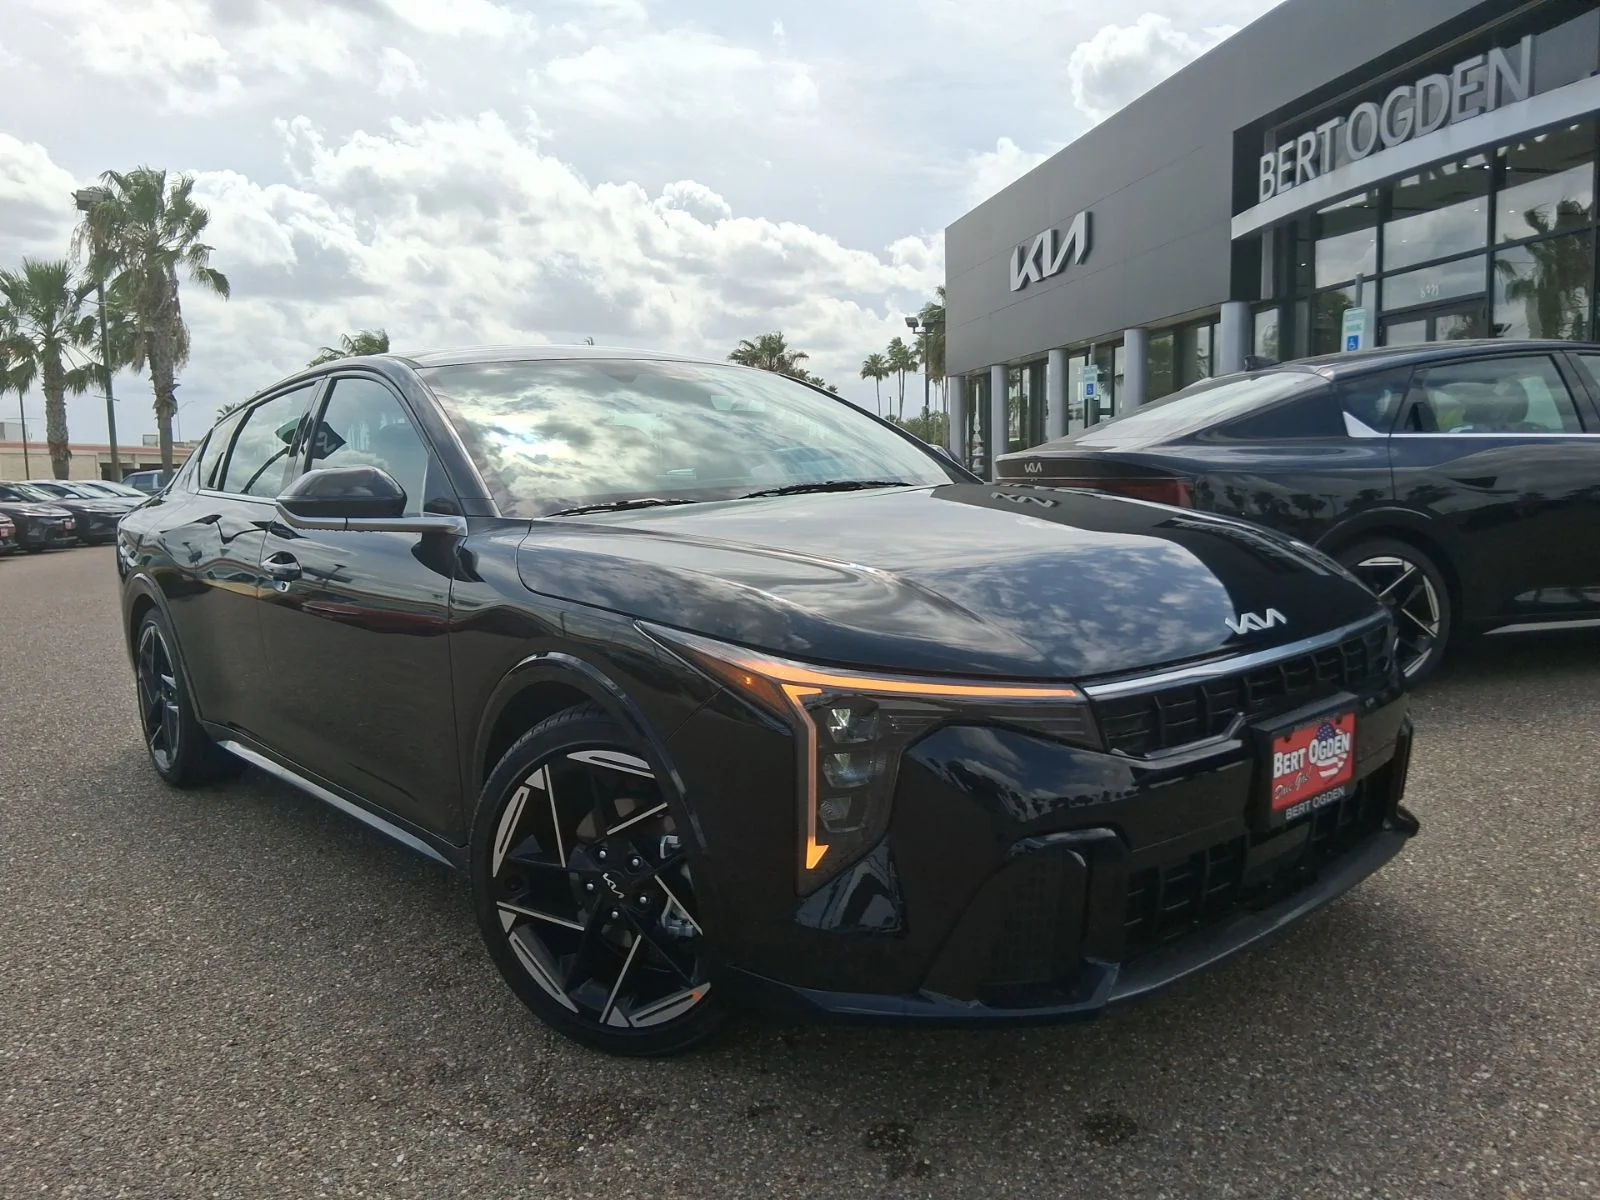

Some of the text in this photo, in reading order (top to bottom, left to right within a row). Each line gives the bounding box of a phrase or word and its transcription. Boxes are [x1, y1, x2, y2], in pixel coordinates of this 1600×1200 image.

[1259, 34, 1536, 203] BERT OGDEN
[1010, 211, 1092, 292] KIA
[1024, 462, 1043, 473] KIA
[1224, 608, 1288, 635] KIA
[1273, 732, 1351, 779] BERT OGDEN
[1285, 800, 1311, 820] BERT
[1312, 786, 1346, 808] OGDEN
